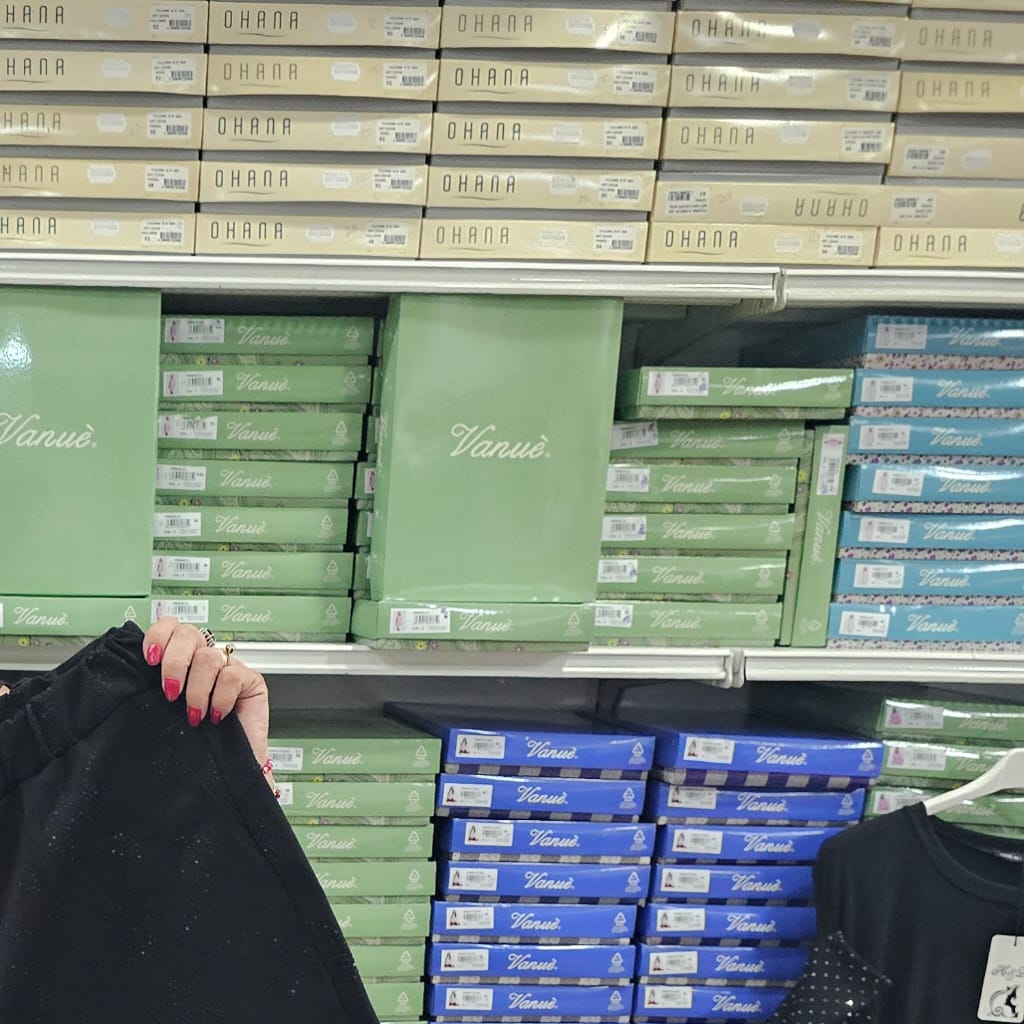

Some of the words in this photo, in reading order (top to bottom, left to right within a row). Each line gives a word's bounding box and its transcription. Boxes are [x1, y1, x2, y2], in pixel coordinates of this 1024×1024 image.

[224, 10, 298, 29] OHANA
[458, 14, 533, 32] OHANA
[920, 29, 992, 47] OHANA
[223, 63, 297, 80] OHANA
[454, 69, 529, 86] OHANA
[916, 80, 990, 97] OHANA
[217, 117, 291, 135] OHANA
[447, 123, 521, 140] OHANA
[680, 127, 754, 144] OHANA
[215, 171, 288, 187] OHANA
[443, 176, 515, 193] OHANA
[210, 221, 283, 239] OHANA
[436, 228, 509, 245] OHANA
[665, 230, 738, 248] OHANA
[894, 235, 967, 252] OHANA
[237, 325, 289, 346] Vanuè
[236, 373, 288, 391] Vanuè
[936, 379, 988, 399] Vanuè
[227, 422, 277, 441] Vanuè
[671, 431, 723, 449] Vanuè
[930, 427, 982, 447] Vanuè
[450, 423, 550, 459] Vanuè
[220, 470, 271, 488] Vanuè
[662, 475, 713, 494] Vanuè
[938, 476, 990, 494] Vanuè
[215, 516, 266, 534] Vanuè
[662, 521, 714, 540] Vanuè
[221, 561, 271, 579] Vanuè
[652, 567, 704, 585] Vanuè
[918, 569, 970, 588] Vanuè
[14, 607, 68, 626] Vanuè
[221, 606, 271, 624] Vanuè
[460, 613, 511, 632] Vanuè
[650, 611, 701, 629] Vanuè
[907, 615, 958, 633] Vanuè
[312, 748, 363, 766] Vanuè
[527, 740, 578, 760] Vanuè
[755, 746, 807, 766] Vanuè
[306, 792, 356, 810] Vanuè
[517, 786, 567, 805] Vanuè
[736, 793, 788, 812] Vanuè
[306, 832, 355, 849] Vanuè
[530, 830, 579, 847] Vanuè
[744, 834, 794, 852] Vanuè
[524, 871, 574, 890] Vanuè
[731, 874, 783, 892] Vanuè
[511, 912, 560, 931] Vanuè
[726, 913, 776, 932] Vanuè
[508, 954, 557, 972] Vanuè
[716, 955, 765, 973] Vanuè
[509, 993, 557, 1010] Vanuè
[712, 995, 761, 1013] Vanuè
